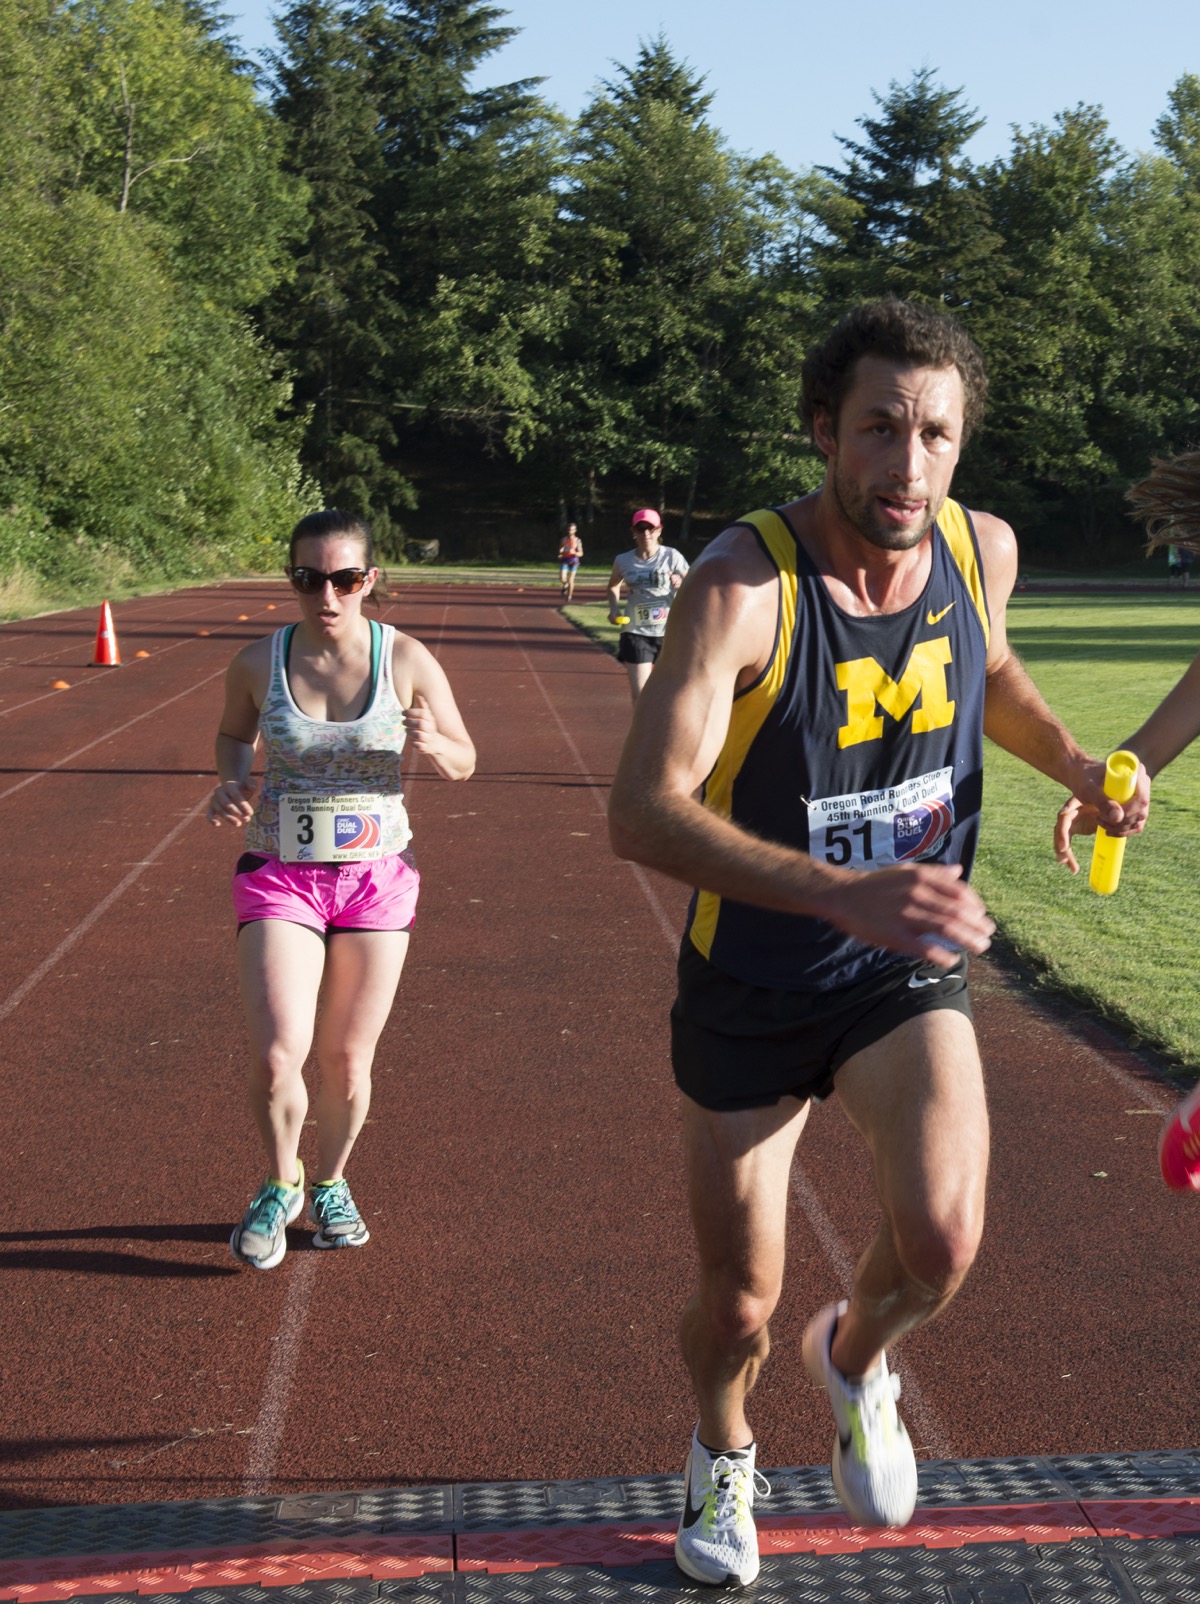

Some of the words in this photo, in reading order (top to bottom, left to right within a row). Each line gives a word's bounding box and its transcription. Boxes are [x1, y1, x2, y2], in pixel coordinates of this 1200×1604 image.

[638, 609, 649, 621] 19
[834, 636, 956, 749] M
[287, 797, 311, 805] Oregon
[332, 796, 359, 804] Runners
[821, 799, 857, 812] Oregon
[860, 791, 885, 805] Road
[888, 781, 921, 800] Runners
[922, 771, 941, 785] Club
[826, 811, 850, 823] 45th
[853, 802, 894, 819] Running
[902, 794, 919, 808] Dual
[921, 782, 938, 798] Duel
[307, 805, 335, 813] Running
[297, 814, 314, 845] 3
[896, 817, 924, 831] DUAL
[897, 827, 924, 839] DUEL
[825, 820, 874, 866] 51
